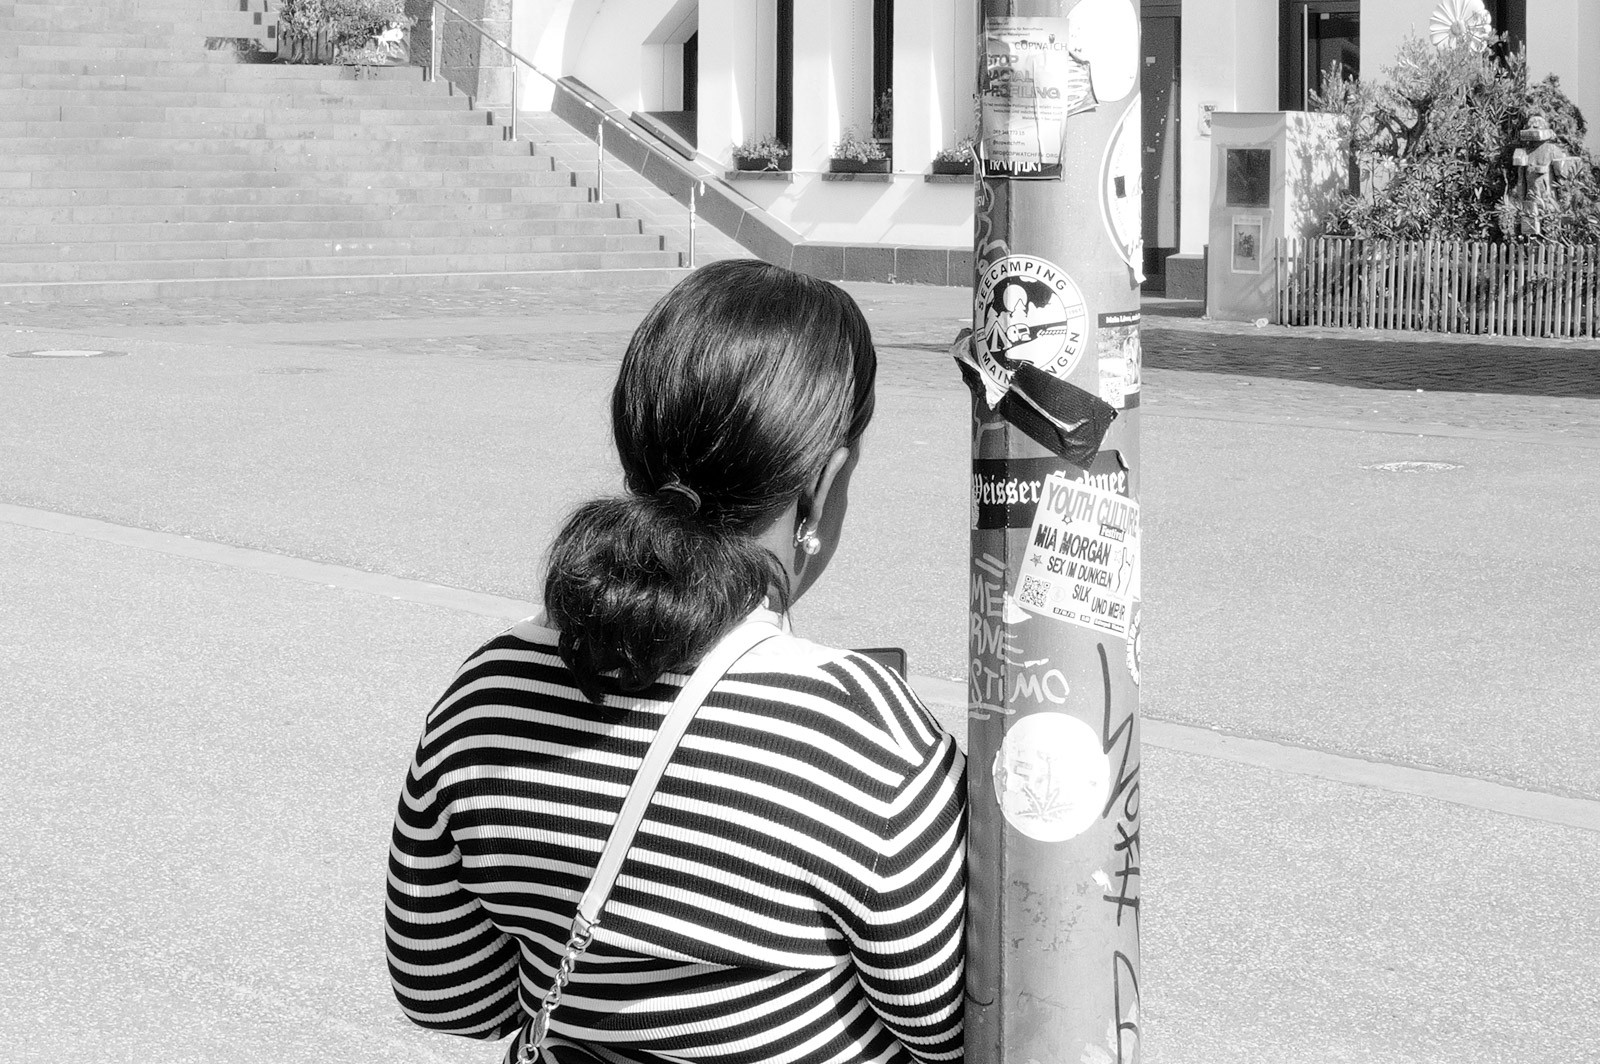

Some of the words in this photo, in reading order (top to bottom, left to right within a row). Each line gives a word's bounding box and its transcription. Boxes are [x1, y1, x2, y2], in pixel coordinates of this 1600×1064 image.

[1014, 40, 1068, 51] COPWATCH
[987, 54, 1019, 67] STOP
[977, 261, 1068, 311] SEECAMPING
[1046, 481, 1097, 523] YOUTH
[1034, 523, 1058, 551] MIA
[1059, 531, 1112, 567] MORGAN
[1047, 555, 1067, 575] SEX
[1065, 561, 1078, 578] IM
[1077, 564, 1114, 589] DUNKELN
[1072, 583, 1092, 603] SILK
[1091, 596, 1108, 615] UND
